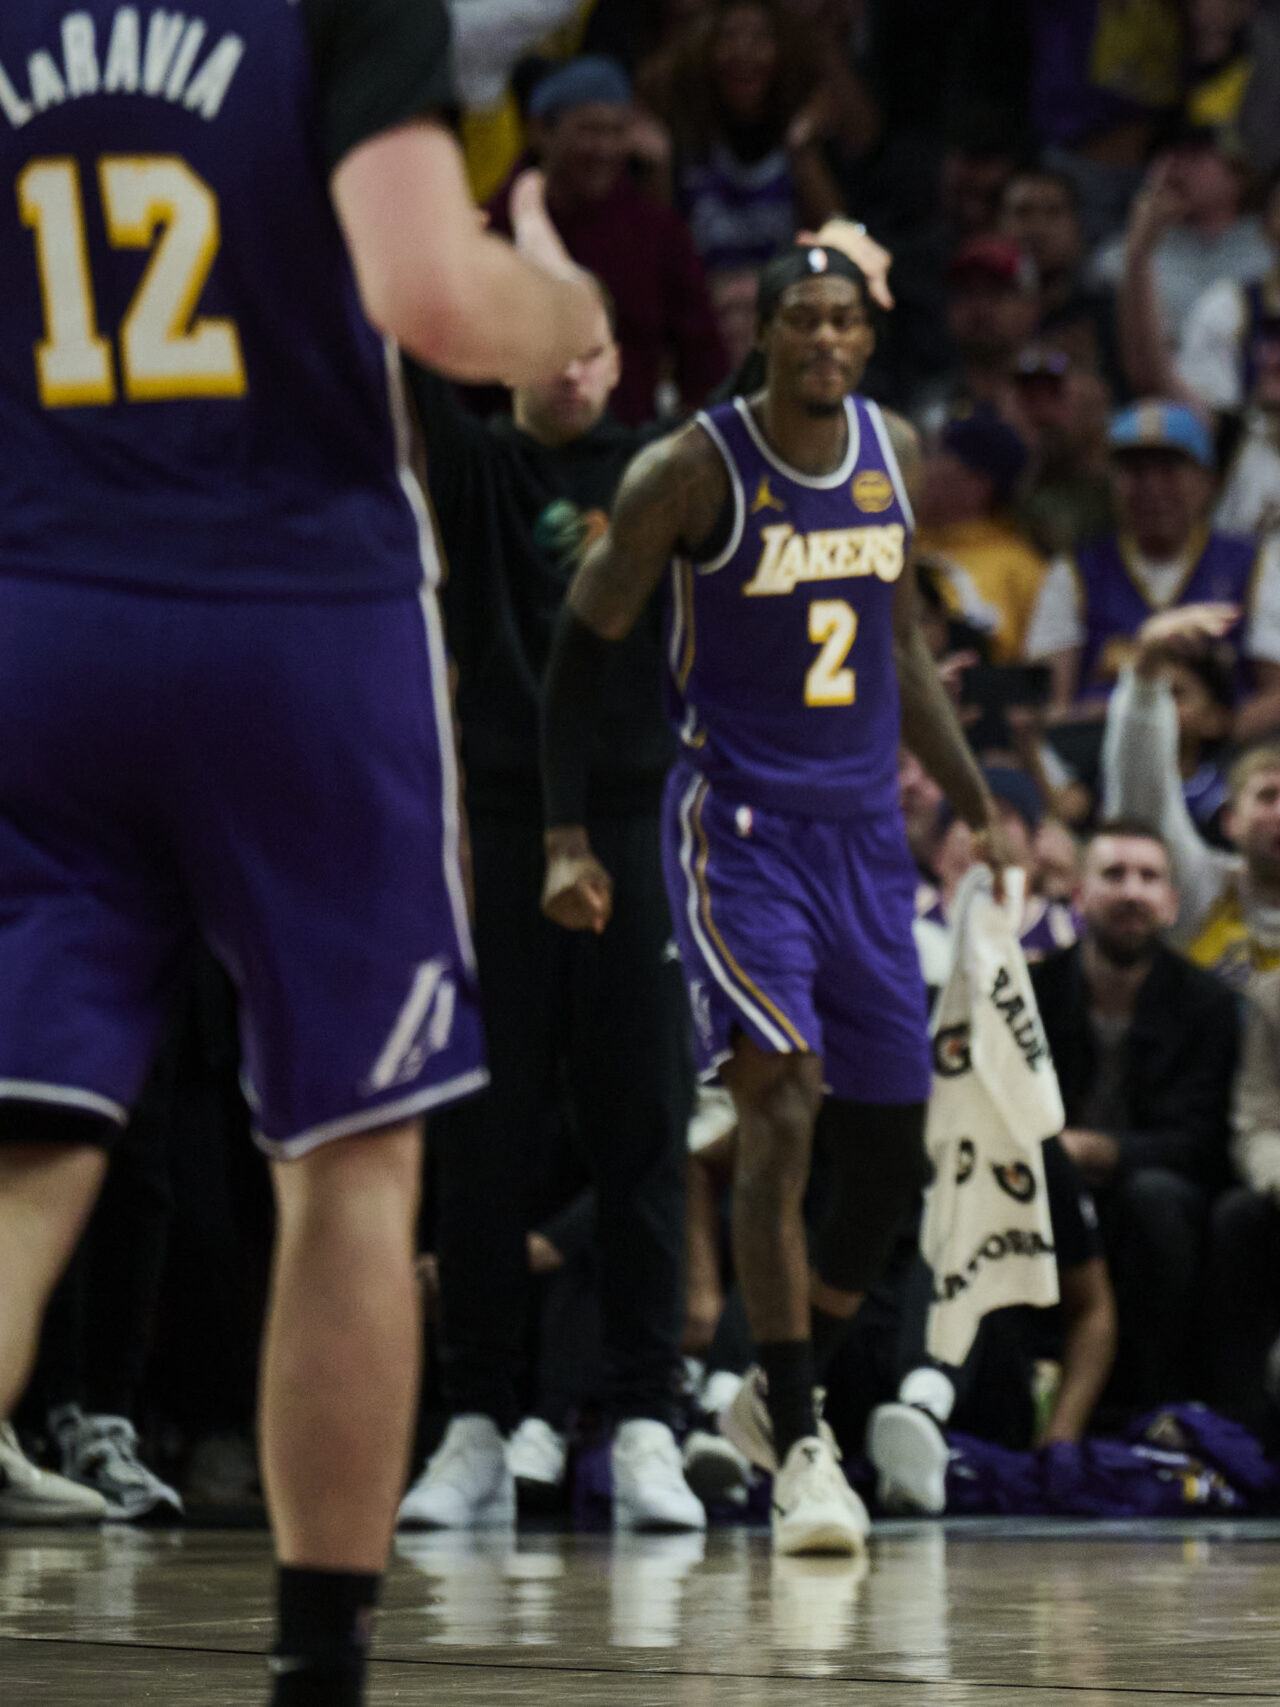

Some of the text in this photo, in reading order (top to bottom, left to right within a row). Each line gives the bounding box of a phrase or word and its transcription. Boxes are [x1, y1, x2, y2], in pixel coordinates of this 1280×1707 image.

[17, 154, 248, 409] 12
[742, 522, 906, 597] LAKERS
[804, 598, 858, 708] 2
